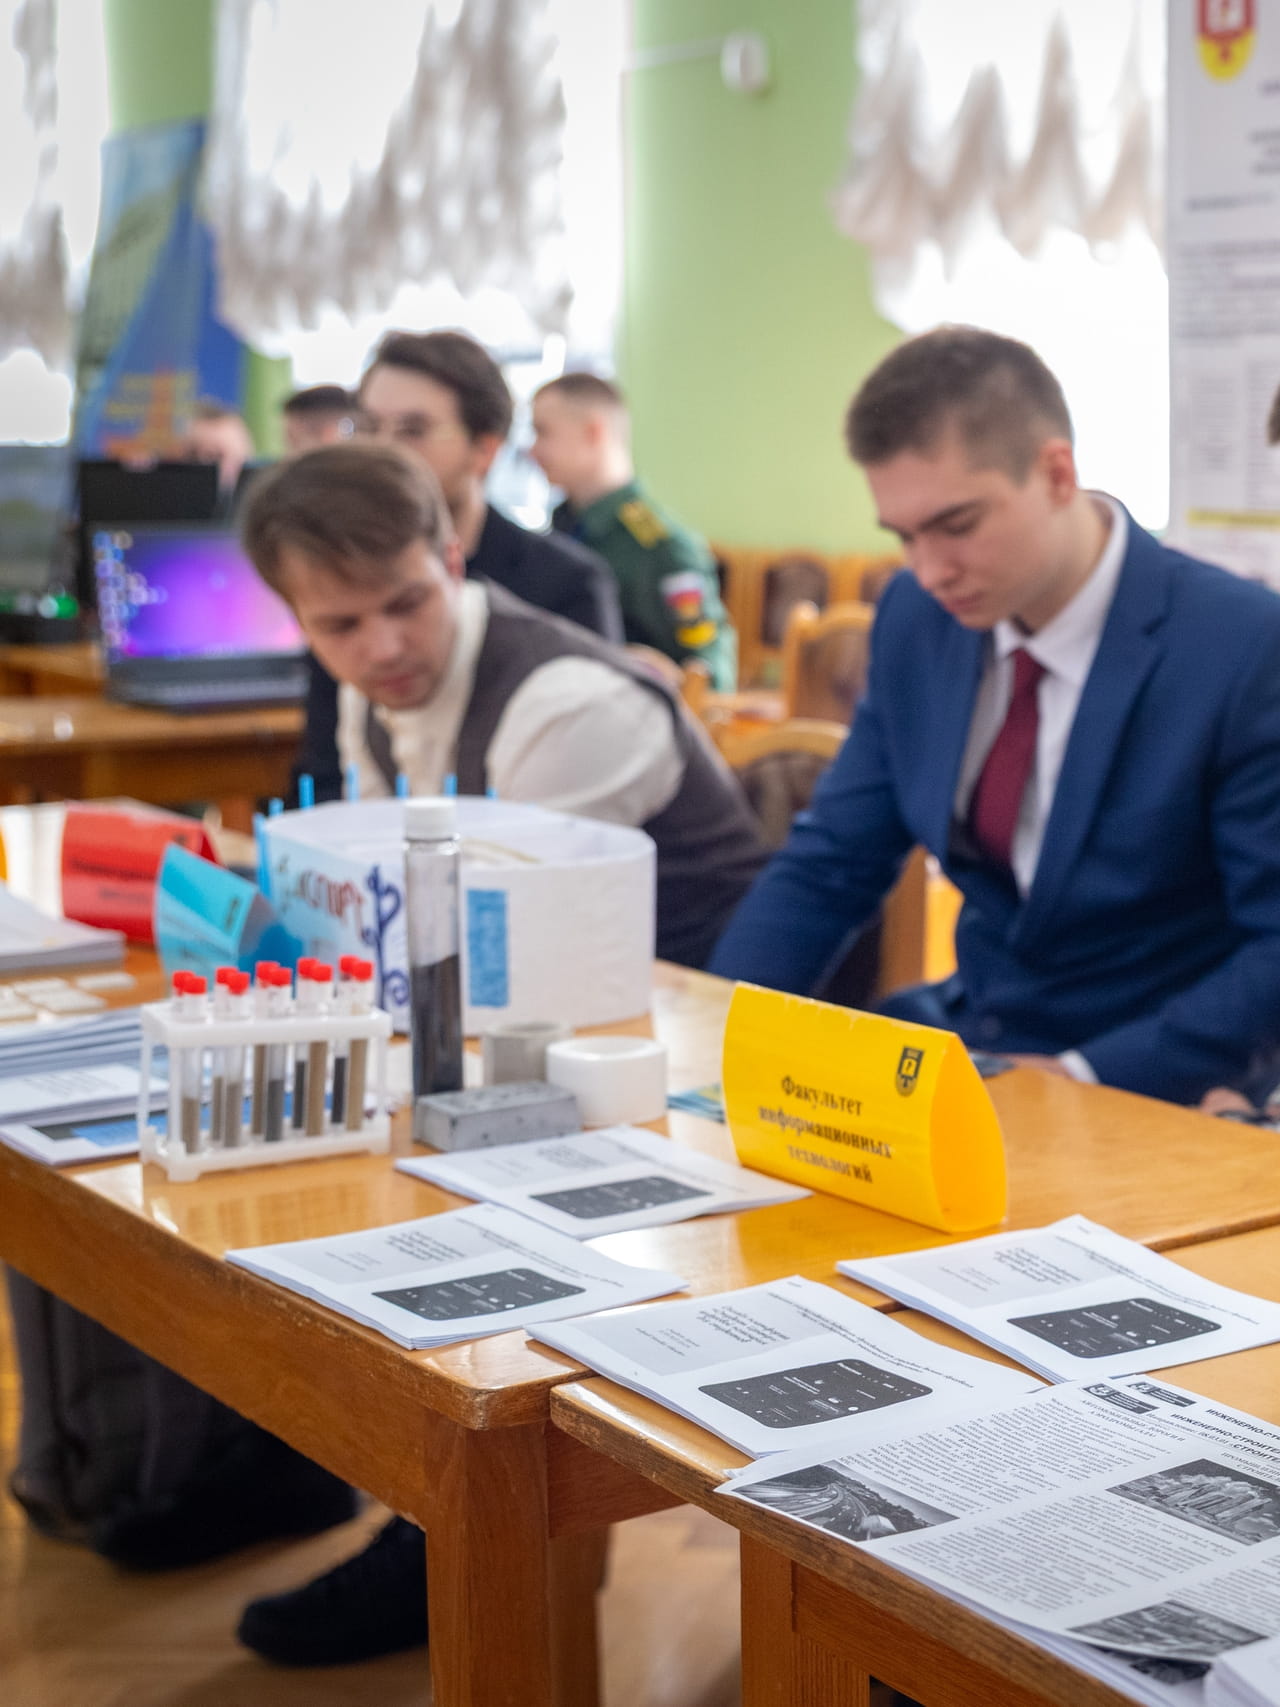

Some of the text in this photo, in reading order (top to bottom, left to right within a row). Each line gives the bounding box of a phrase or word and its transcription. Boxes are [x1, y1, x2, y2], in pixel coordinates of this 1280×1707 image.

[781, 1075, 863, 1117] Факультет
[758, 1104, 893, 1159] информационных
[787, 1143, 874, 1184] технологий
